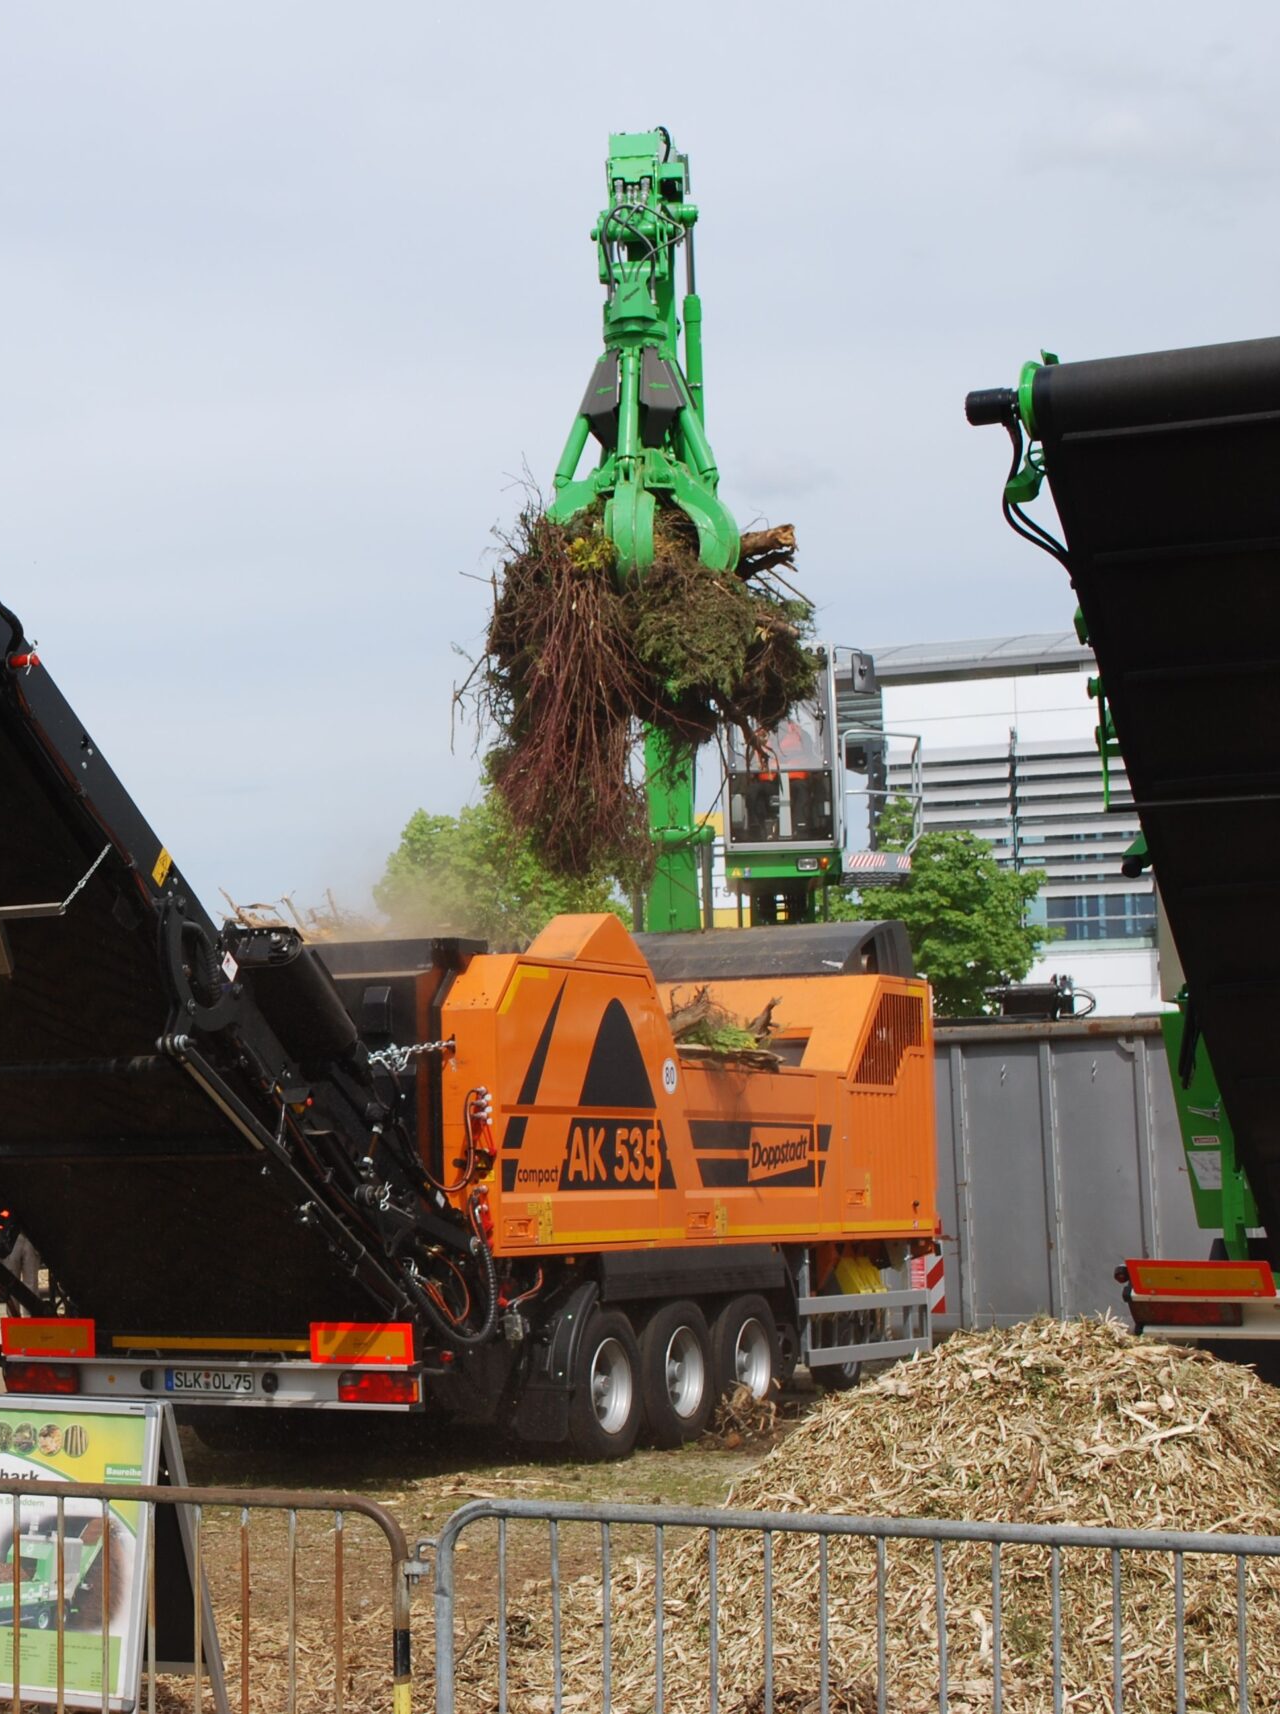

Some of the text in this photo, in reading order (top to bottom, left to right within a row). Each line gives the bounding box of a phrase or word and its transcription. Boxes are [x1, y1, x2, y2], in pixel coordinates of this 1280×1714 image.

[665, 1066, 675, 1085] 80
[568, 1126, 662, 1182] AK 535
[751, 1134, 808, 1170] Doppstadt
[517, 1165, 559, 1187] compact
[174, 1371, 202, 1389] SLK
[234, 1373, 252, 1391] 75
